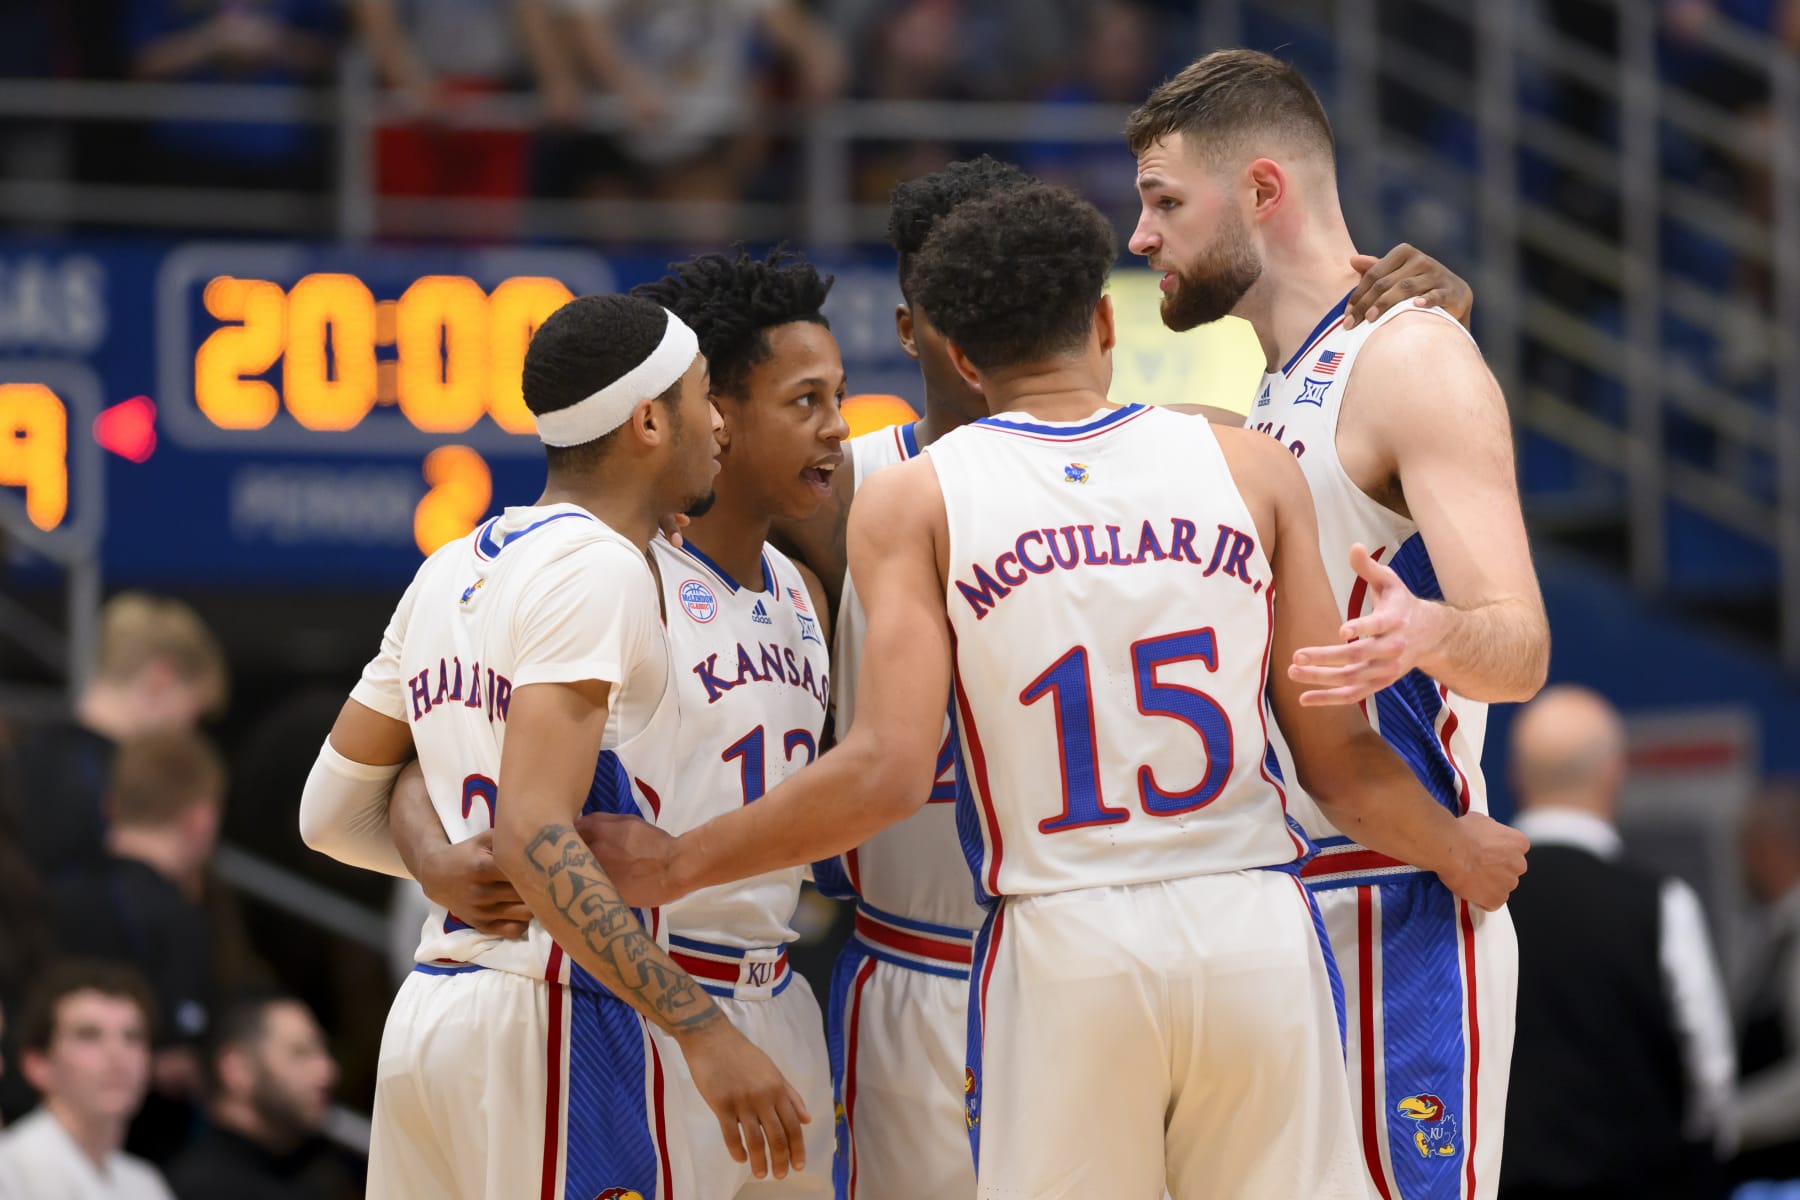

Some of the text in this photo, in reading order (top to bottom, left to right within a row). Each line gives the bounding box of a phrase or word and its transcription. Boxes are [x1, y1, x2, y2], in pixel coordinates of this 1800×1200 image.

[955, 517, 1263, 620] McCULLAR JR.
[692, 641, 829, 712] KANSAS
[1018, 625, 1234, 835] 15
[746, 962, 773, 988] KU
[1430, 1127, 1444, 1140] KU
